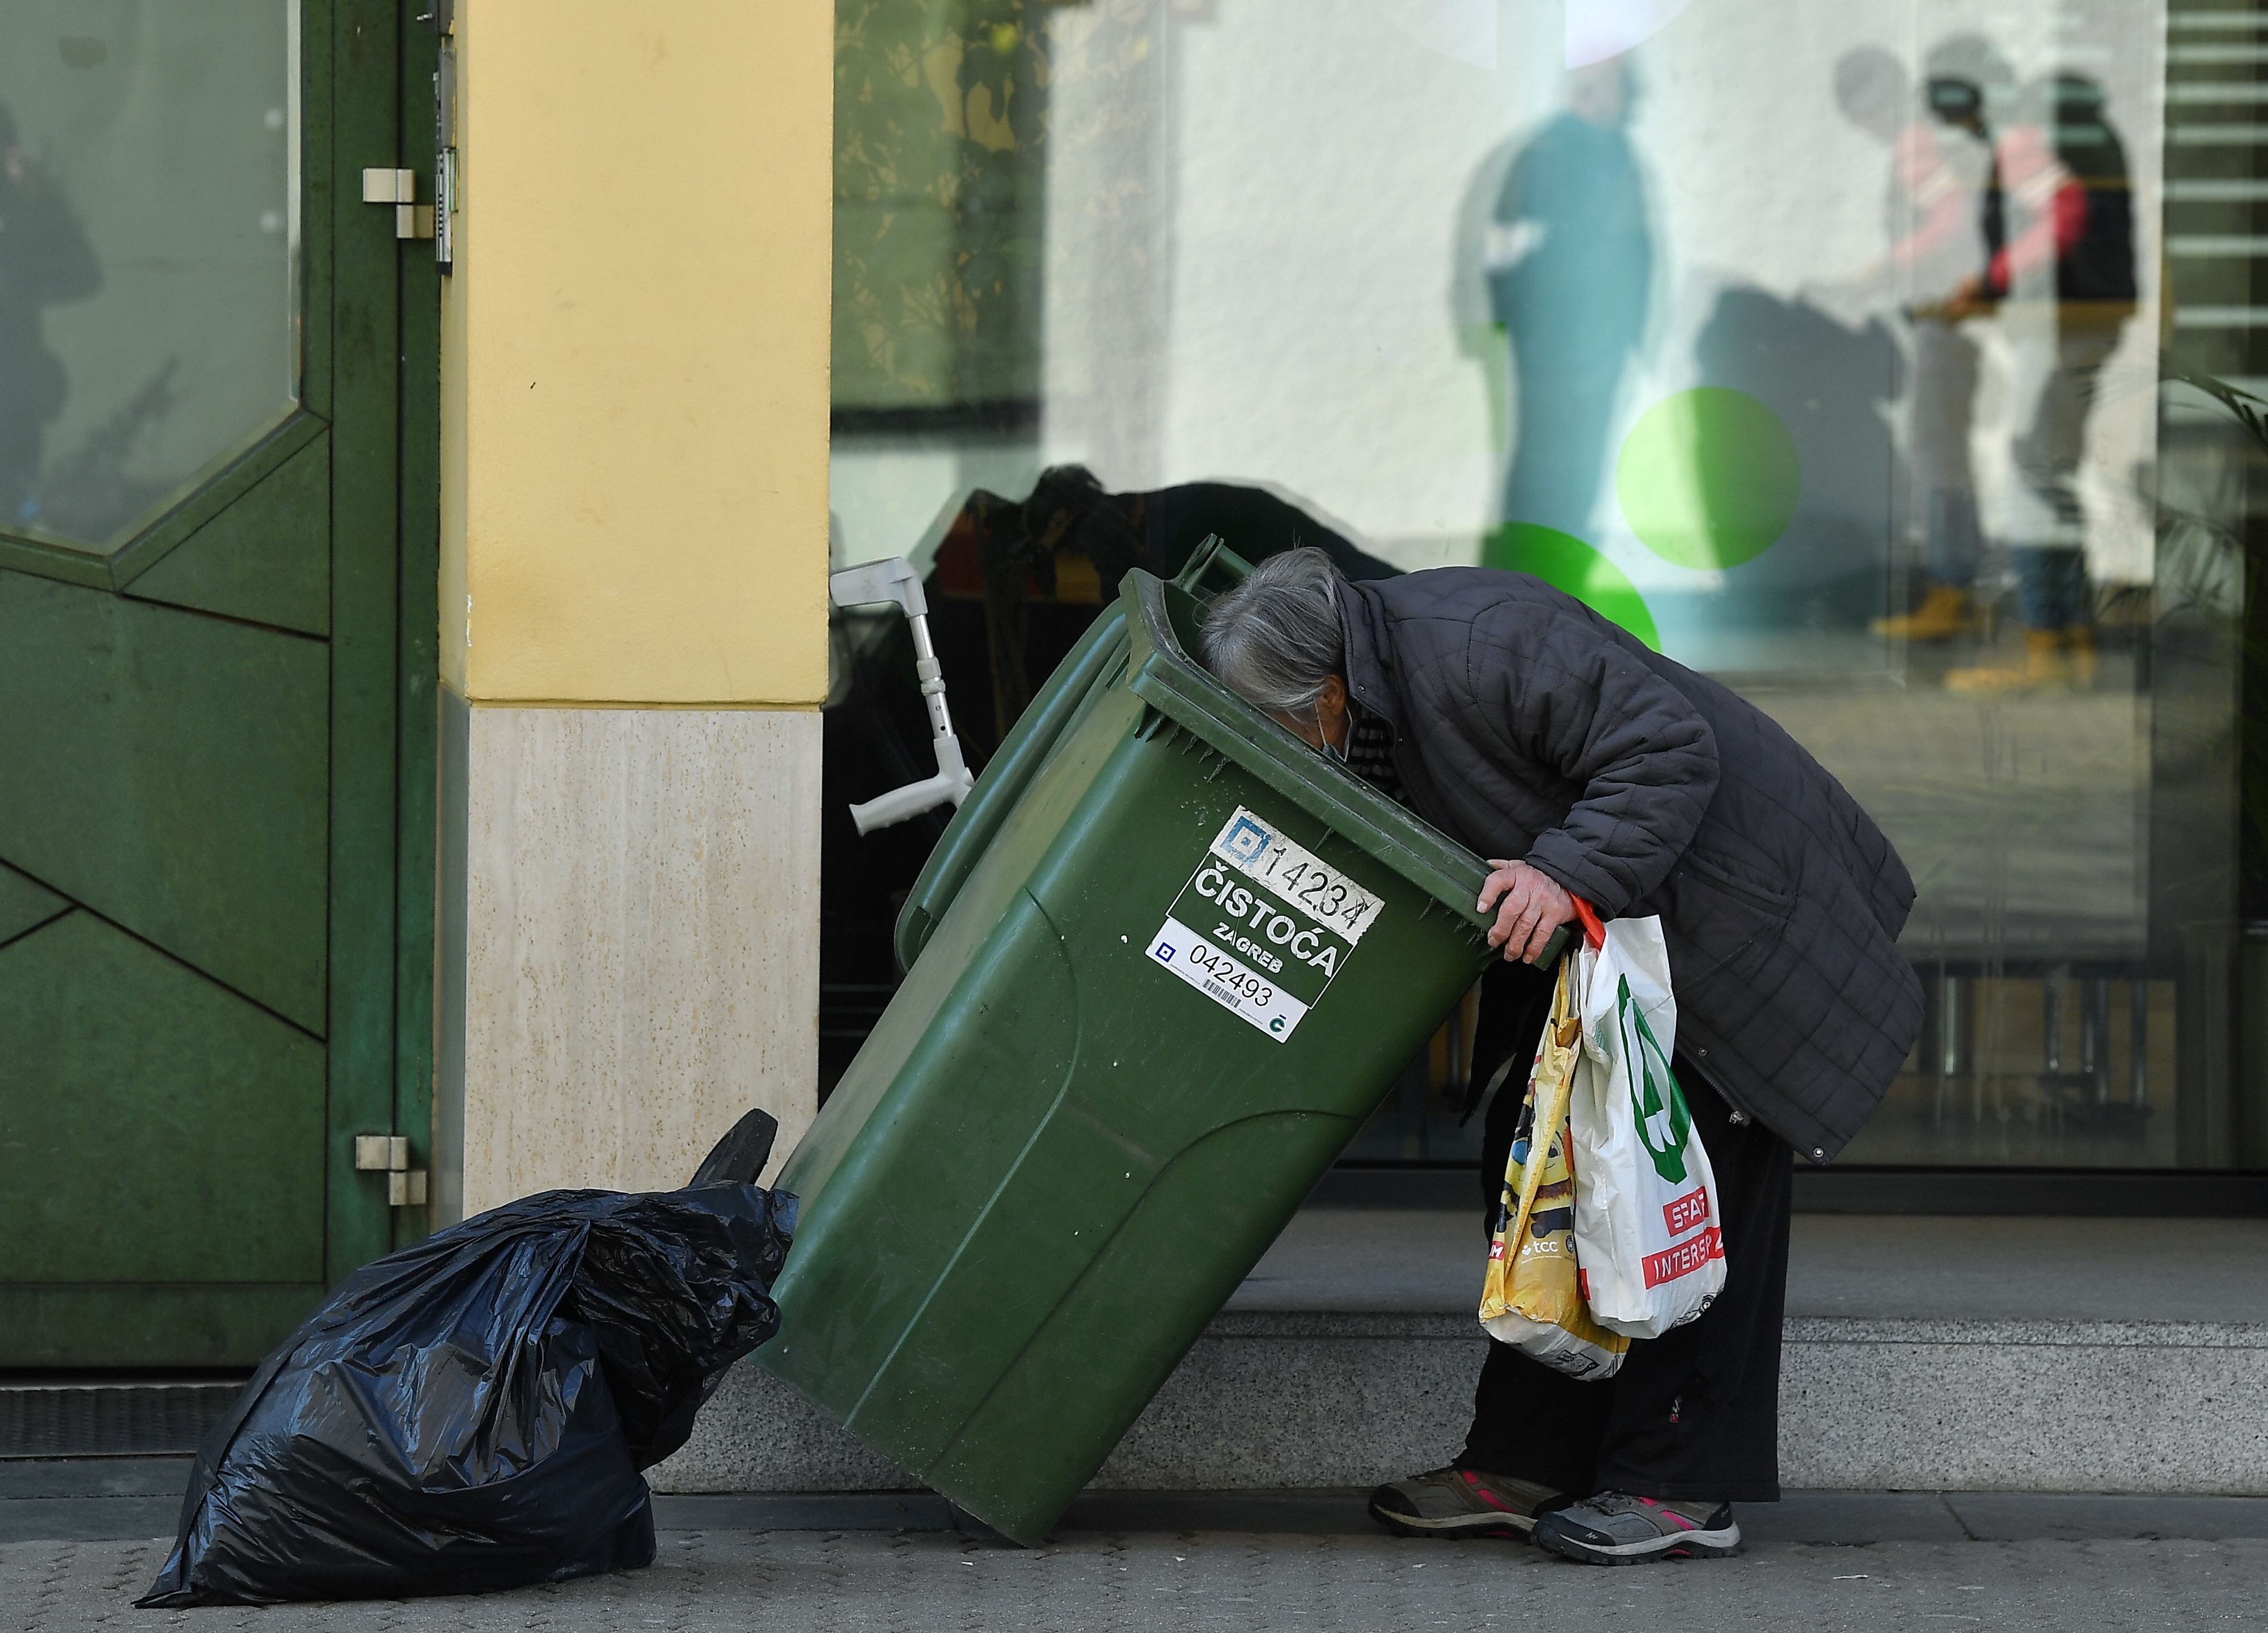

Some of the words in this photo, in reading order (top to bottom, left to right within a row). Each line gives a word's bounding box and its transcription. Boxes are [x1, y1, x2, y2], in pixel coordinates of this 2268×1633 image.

[1195, 860, 1339, 978] ČISTOĆA
[1264, 847, 1369, 930] 14234
[1189, 945, 1273, 1007] 042493
[1212, 921, 1284, 974] ZAGREB
[1533, 1241, 1559, 1254] tcc
